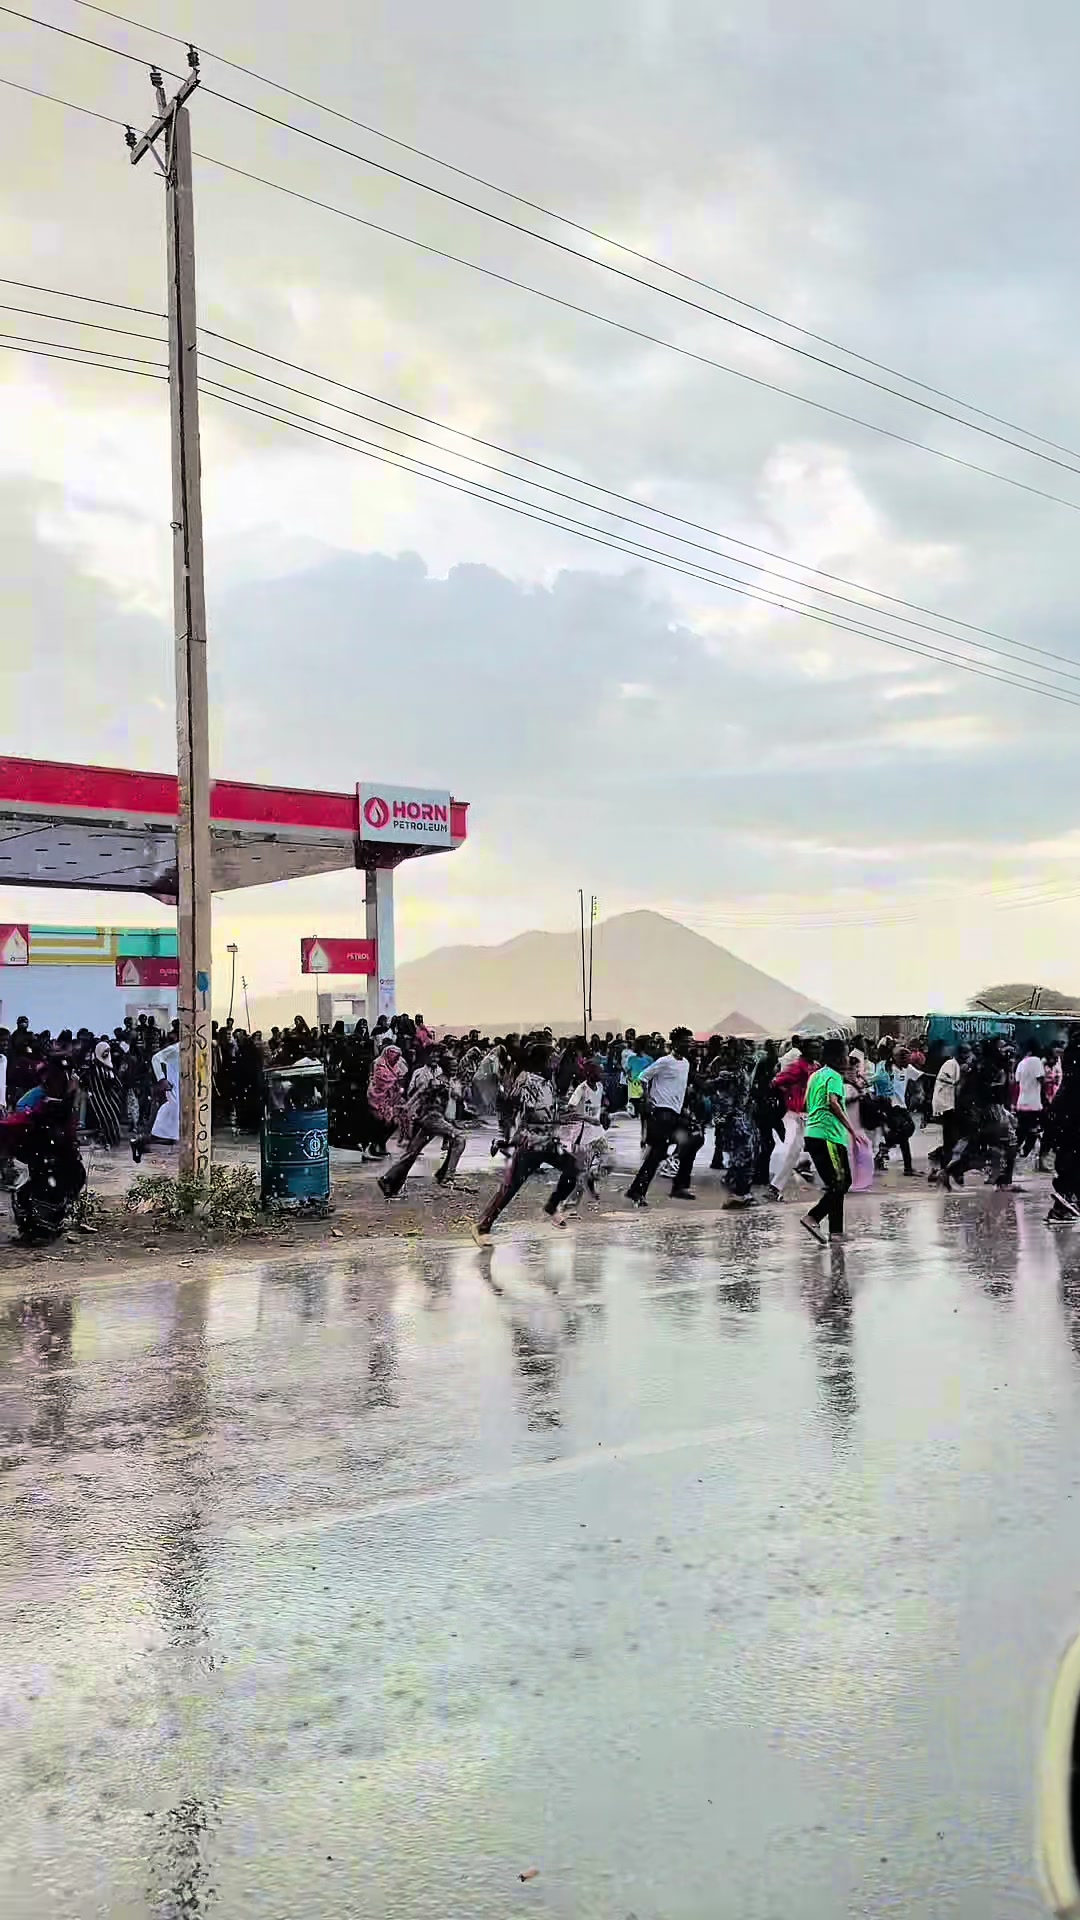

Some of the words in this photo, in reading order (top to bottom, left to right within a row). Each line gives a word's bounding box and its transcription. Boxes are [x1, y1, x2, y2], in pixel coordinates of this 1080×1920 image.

[392, 800, 448, 822] HORN
[393, 820, 448, 833] PETROLEUM
[346, 952, 369, 961] PETROL
